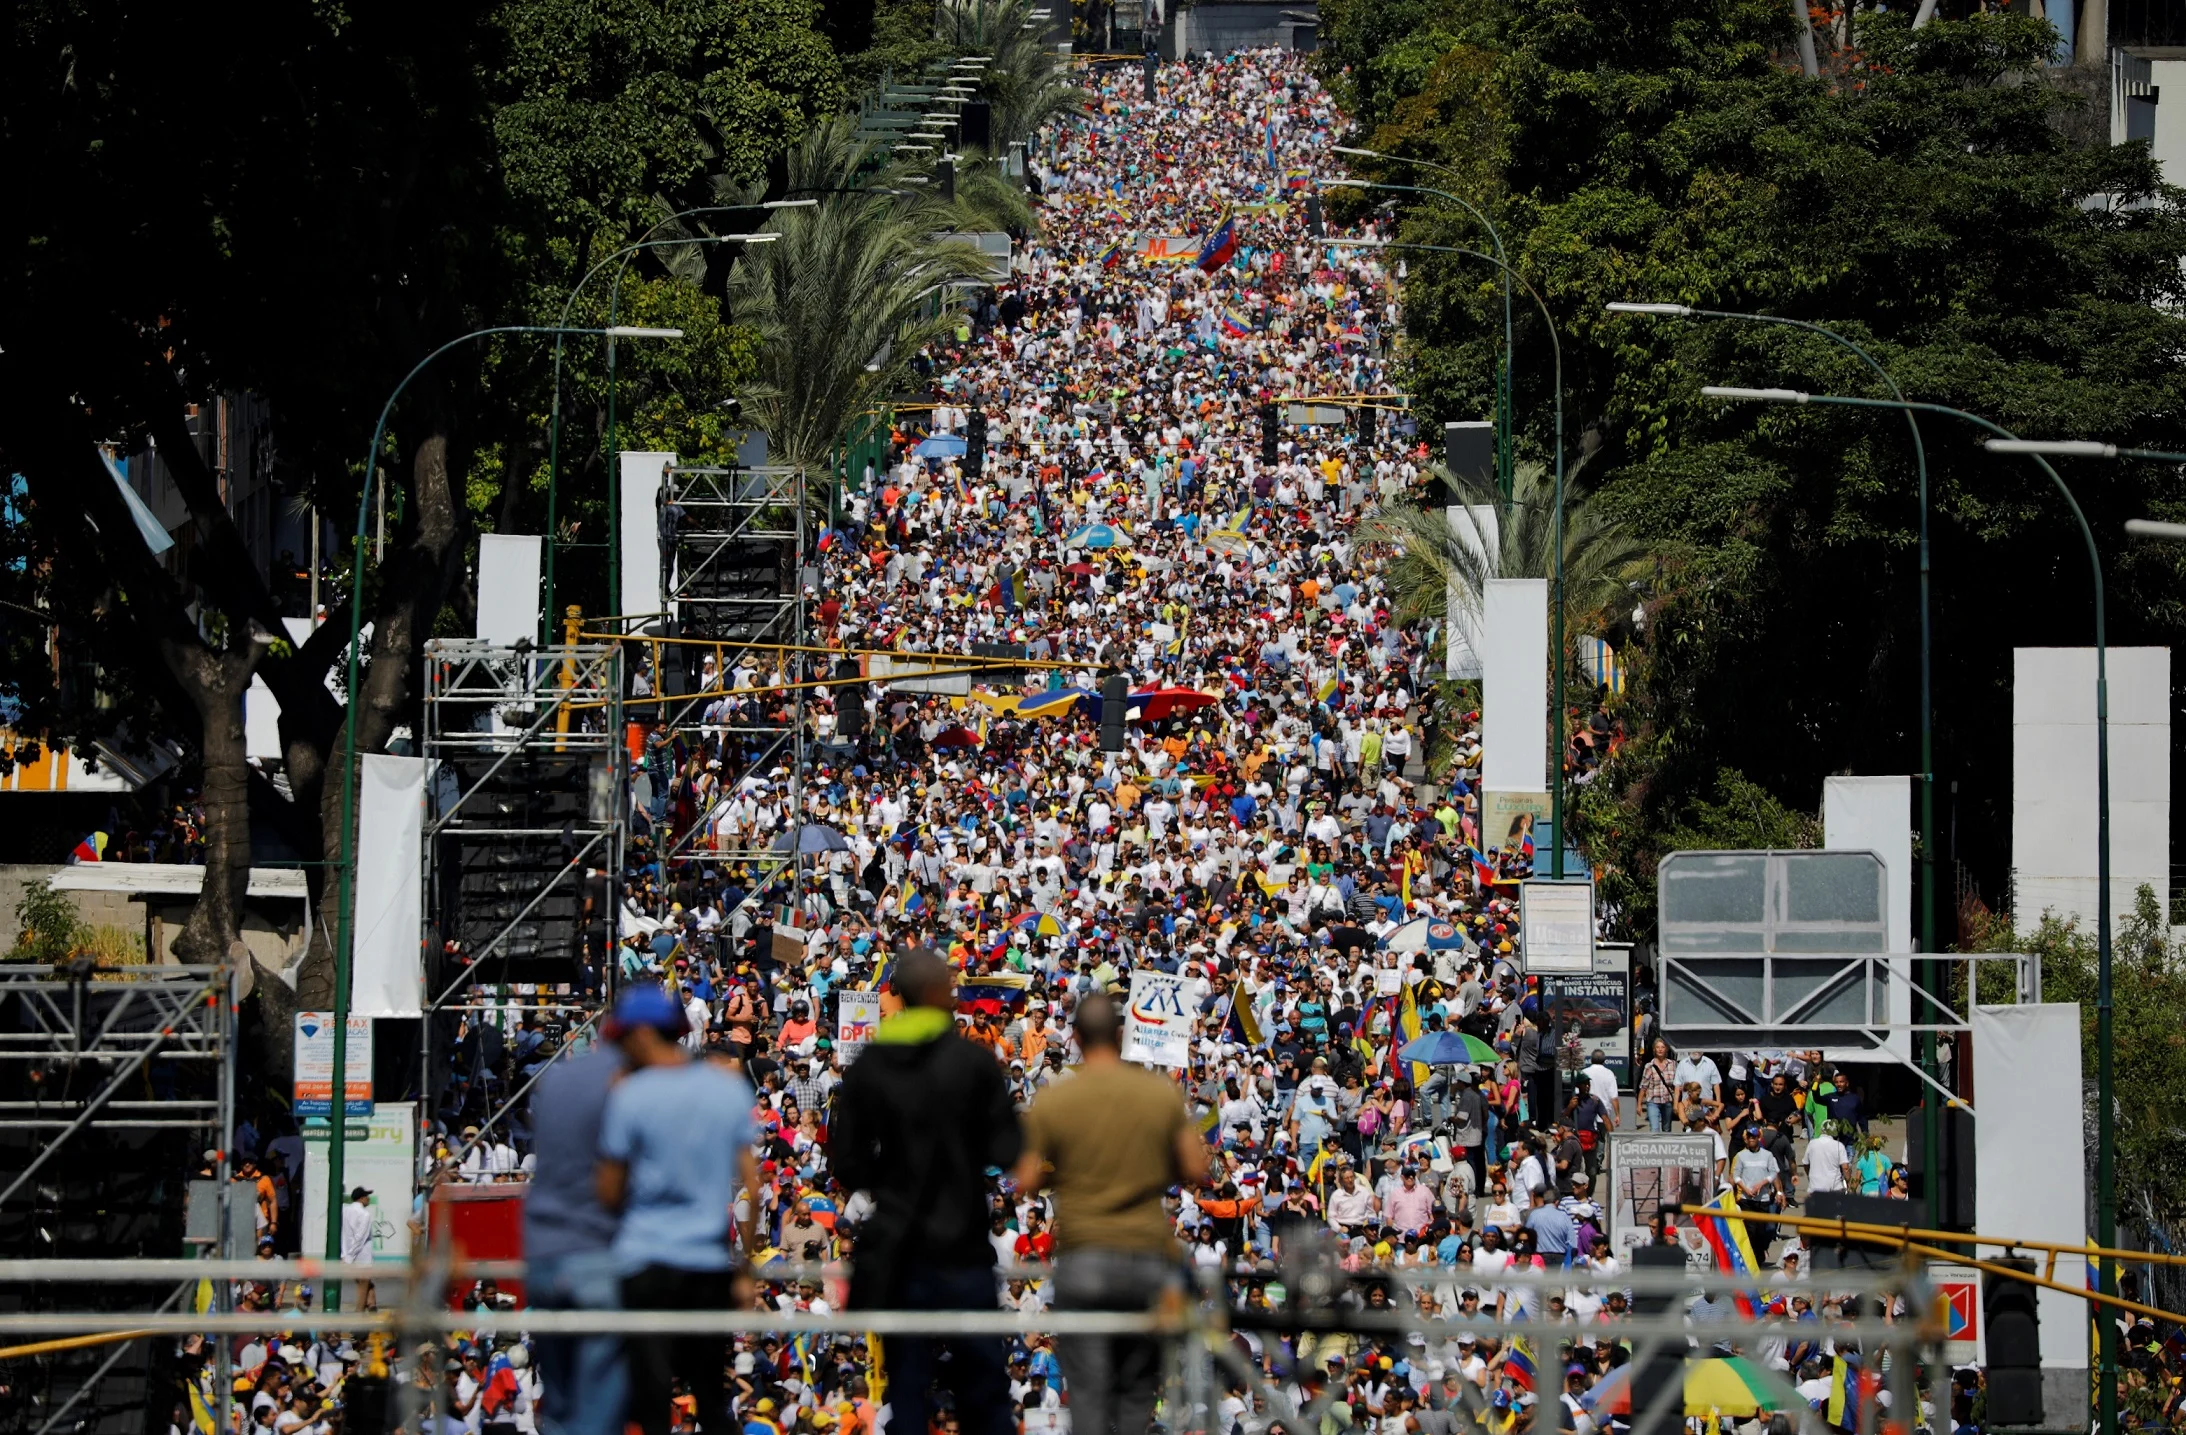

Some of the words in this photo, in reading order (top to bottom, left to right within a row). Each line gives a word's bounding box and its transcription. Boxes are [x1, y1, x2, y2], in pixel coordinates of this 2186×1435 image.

[1564, 986, 1624, 996] INSTANTE
[841, 1025, 878, 1042] DPR
[1132, 1025, 1169, 1037] Alianza
[1132, 1037, 1166, 1048] Militar
[1617, 1144, 1689, 1156] ¡ORGANIZA
[1618, 1156, 1663, 1166] Archivos
[1677, 1156, 1708, 1167] Cajas!
